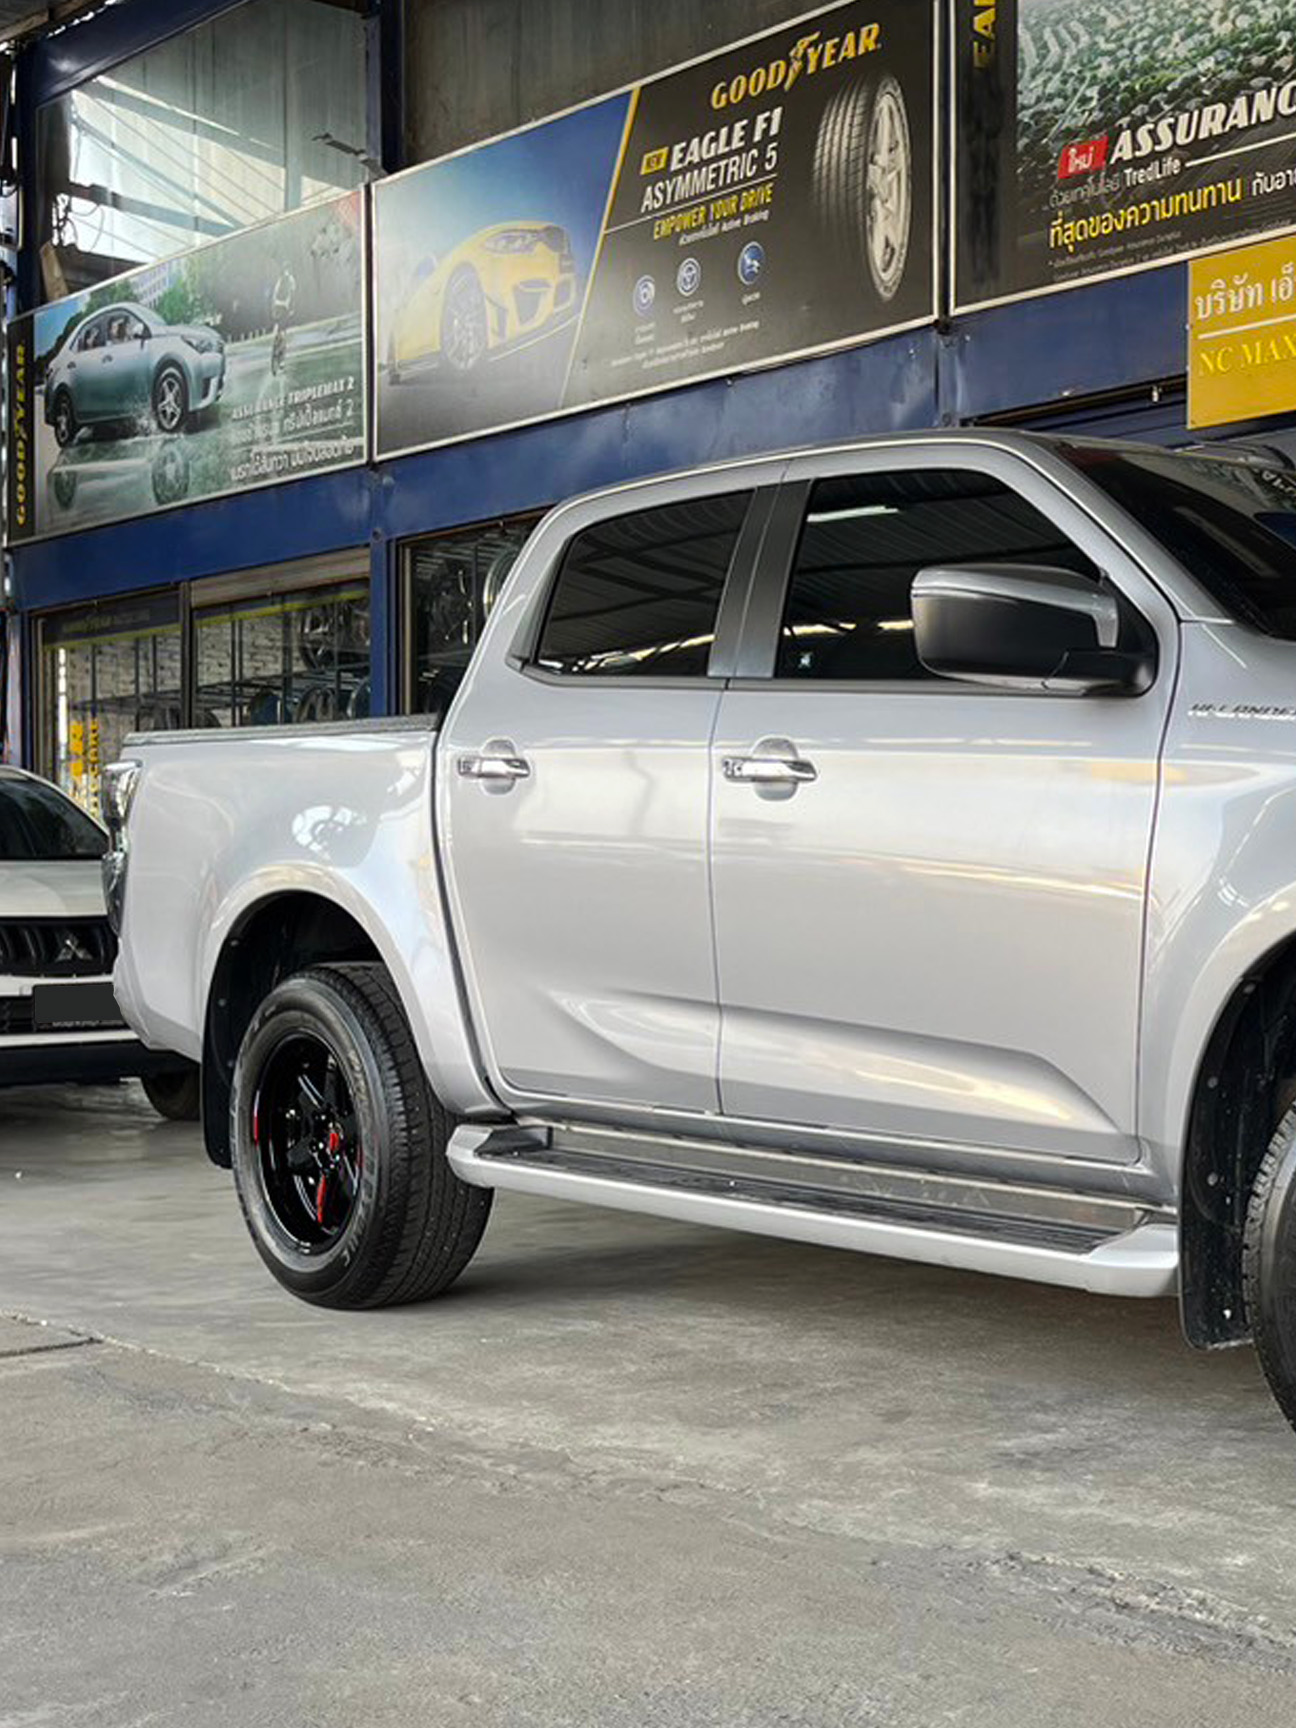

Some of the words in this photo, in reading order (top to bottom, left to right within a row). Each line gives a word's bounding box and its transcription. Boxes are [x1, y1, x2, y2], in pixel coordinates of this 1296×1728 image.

[711, 22, 882, 110] GOODYEAR
[671, 119, 749, 172] EAGLE
[753, 106, 783, 143] F1
[1066, 146, 1095, 174] ใหม่
[641, 148, 758, 213] ASYMMETRIC
[765, 142, 778, 171] 5
[1124, 156, 1181, 188] TredLife
[653, 205, 706, 241] EMPOWER
[709, 194, 739, 221] YOUR
[740, 182, 774, 212] DRIVE
[1049, 176, 1243, 253] ที่สุดของความทนทาน
[1196, 272, 1265, 320] บริษัท
[1199, 345, 1233, 378] NC
